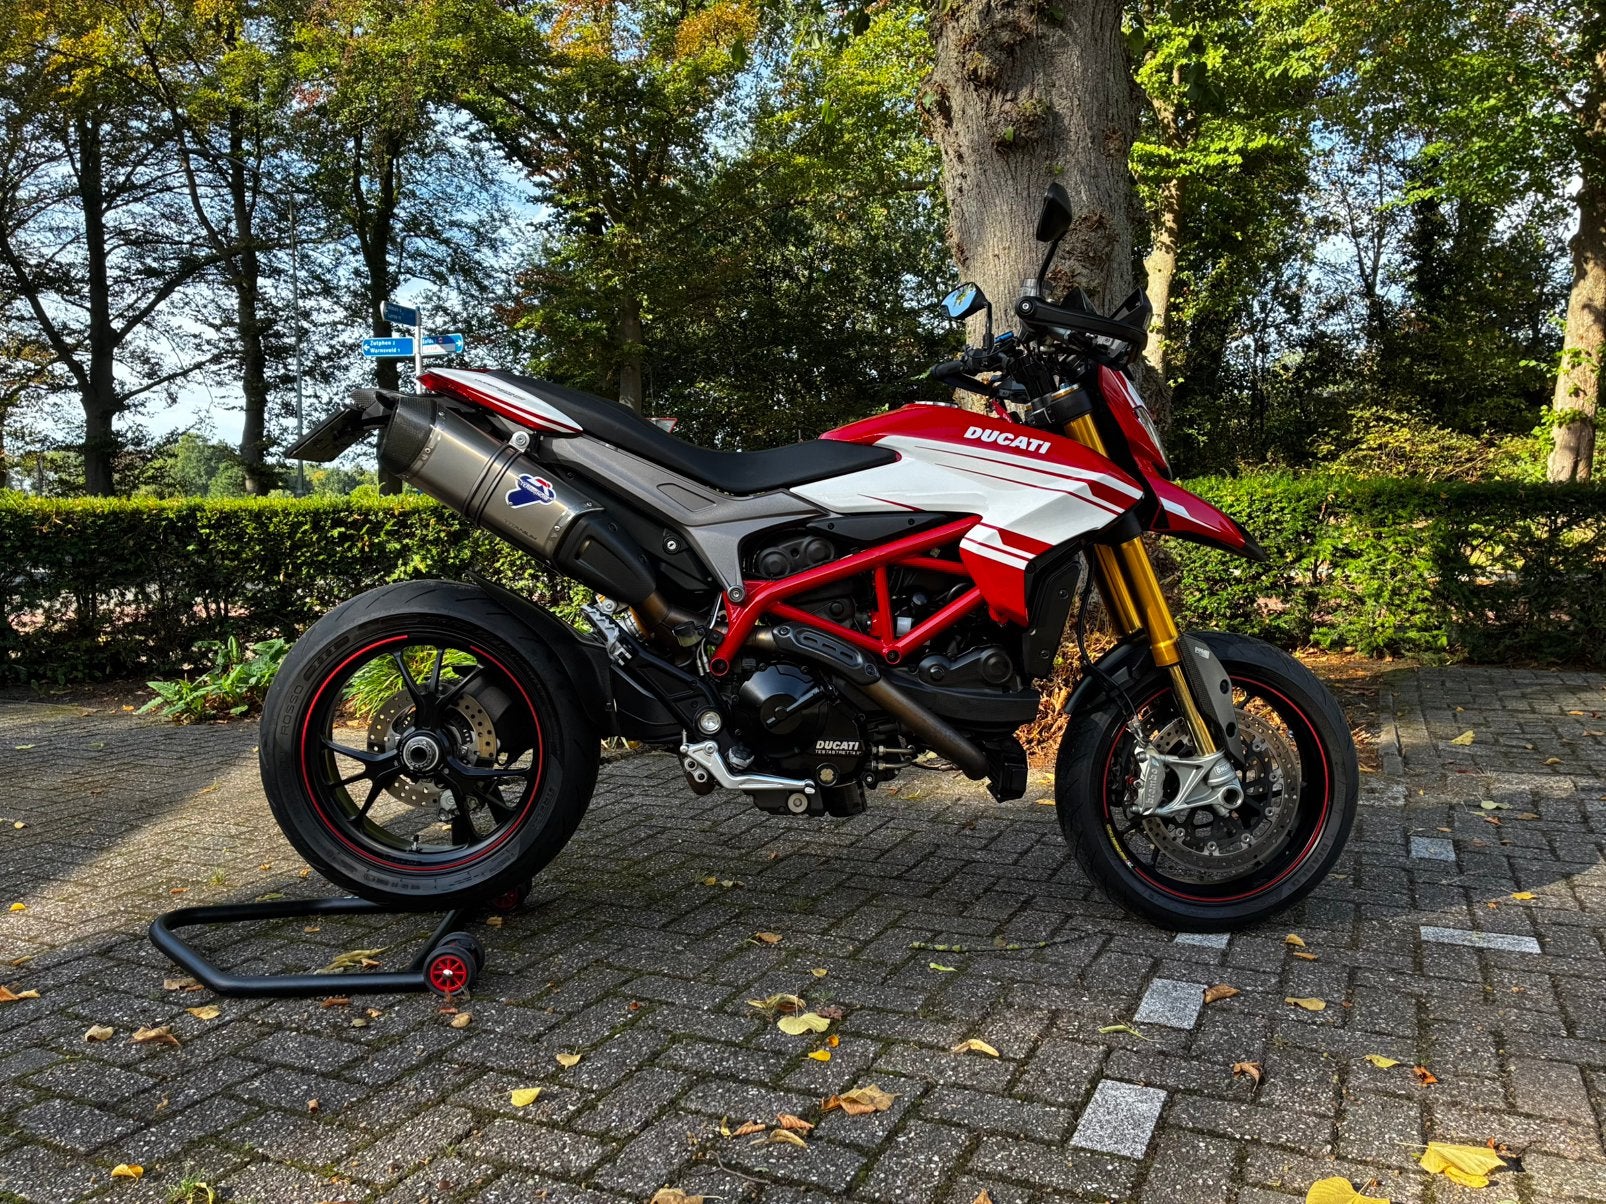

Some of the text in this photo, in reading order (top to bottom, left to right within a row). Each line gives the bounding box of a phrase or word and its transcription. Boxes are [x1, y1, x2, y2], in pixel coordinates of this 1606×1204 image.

[963, 426, 1052, 454] DUCATI
[280, 685, 304, 736] ROSSO
[815, 740, 860, 750] DUCATI
[1145, 768, 1158, 804] brembo
